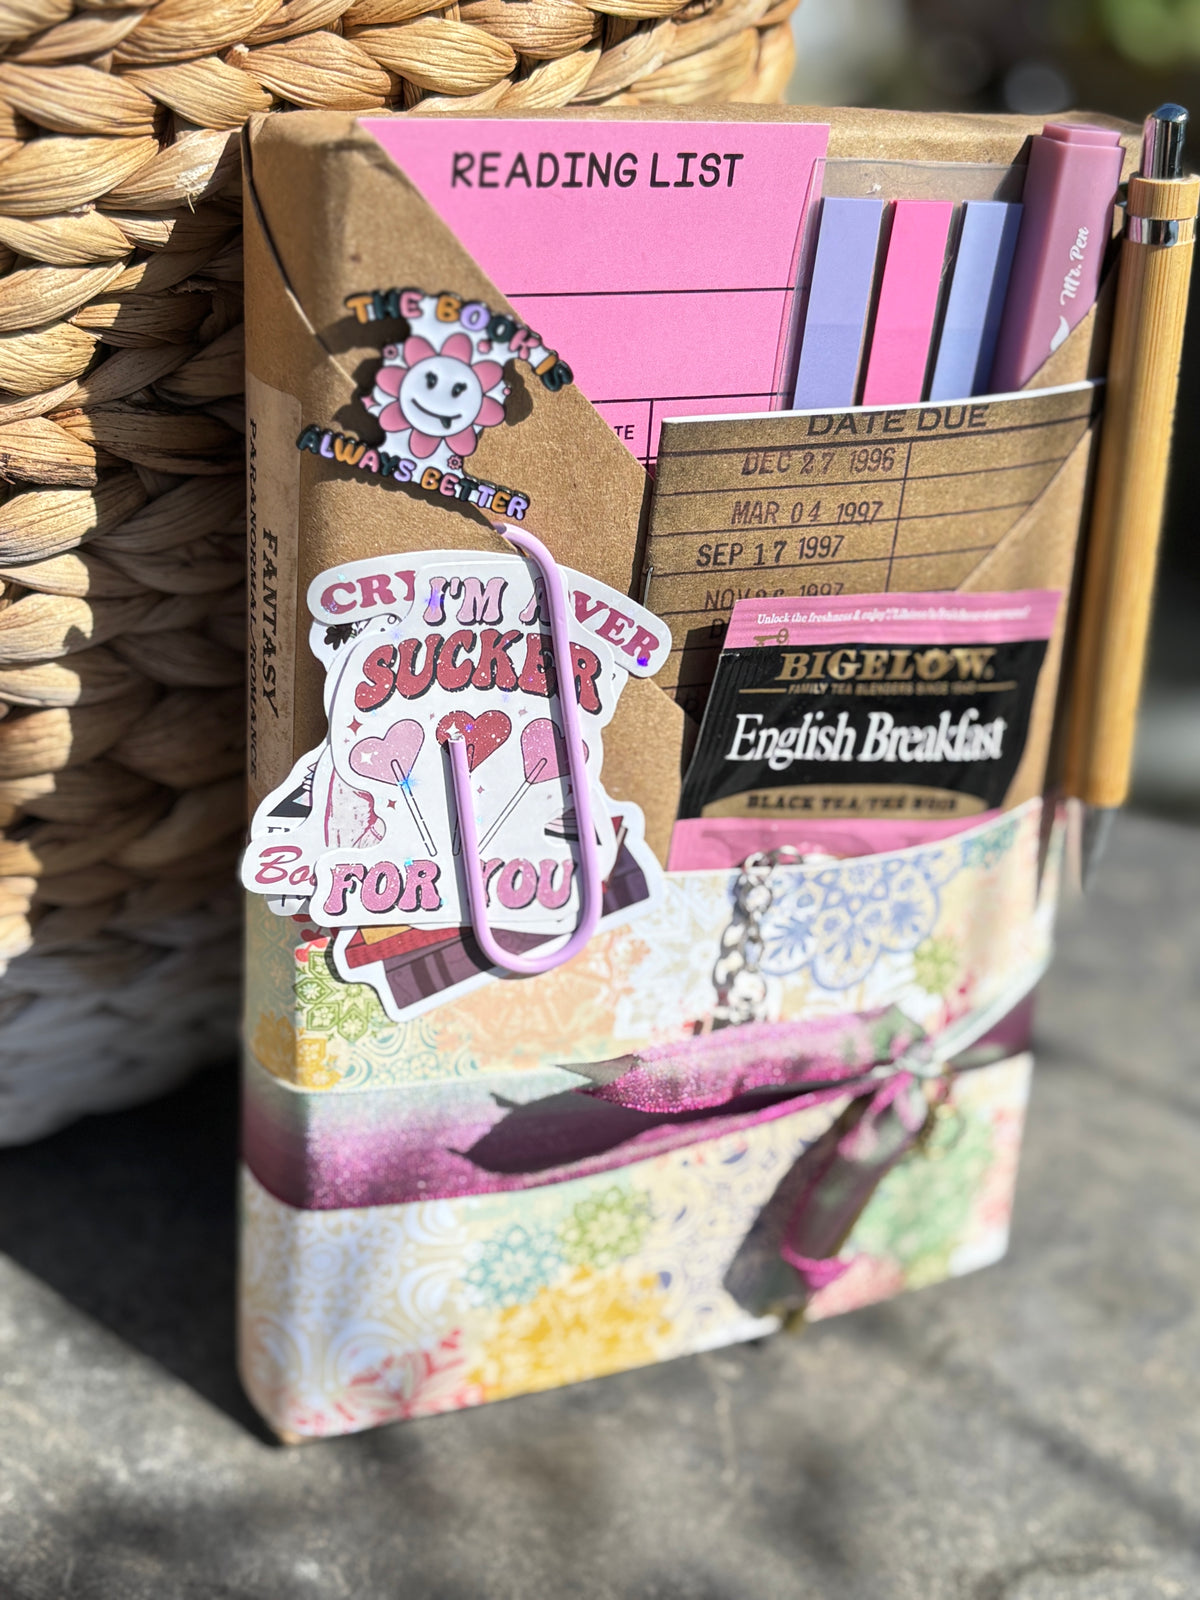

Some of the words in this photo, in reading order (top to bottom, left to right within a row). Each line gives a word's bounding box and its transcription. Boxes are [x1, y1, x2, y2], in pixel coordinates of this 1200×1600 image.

[451, 151, 638, 189] READING
[650, 152, 744, 188] LIST
[1069, 226, 1091, 263] Pen
[1059, 263, 1083, 307] Mr.
[346, 288, 423, 324] THE
[435, 292, 541, 360] BOOK
[534, 350, 574, 392] IS
[807, 409, 907, 436] DATE
[917, 404, 990, 431] DUE
[296, 425, 417, 482] ALWAYS
[421, 466, 531, 521] BETTER
[741, 450, 792, 476] DEC
[850, 447, 896, 474] 1996
[731, 502, 779, 526] MAR
[837, 500, 884, 526] 1997
[696, 542, 743, 567] SEP
[754, 540, 788, 564] 17
[799, 535, 846, 560] 1997
[320, 570, 416, 615] CRY
[423, 576, 508, 627] I'M
[263, 527, 280, 719] FANTASY
[569, 588, 660, 667] VER
[756, 611, 790, 625] Unlock
[791, 611, 809, 624] the
[354, 628, 603, 716] SUCKER
[787, 682, 829, 695] FAMILY
[726, 710, 858, 771] English
[857, 707, 1007, 763] Breakfast
[747, 794, 815, 810] BLACK
[323, 859, 442, 914] FOR
